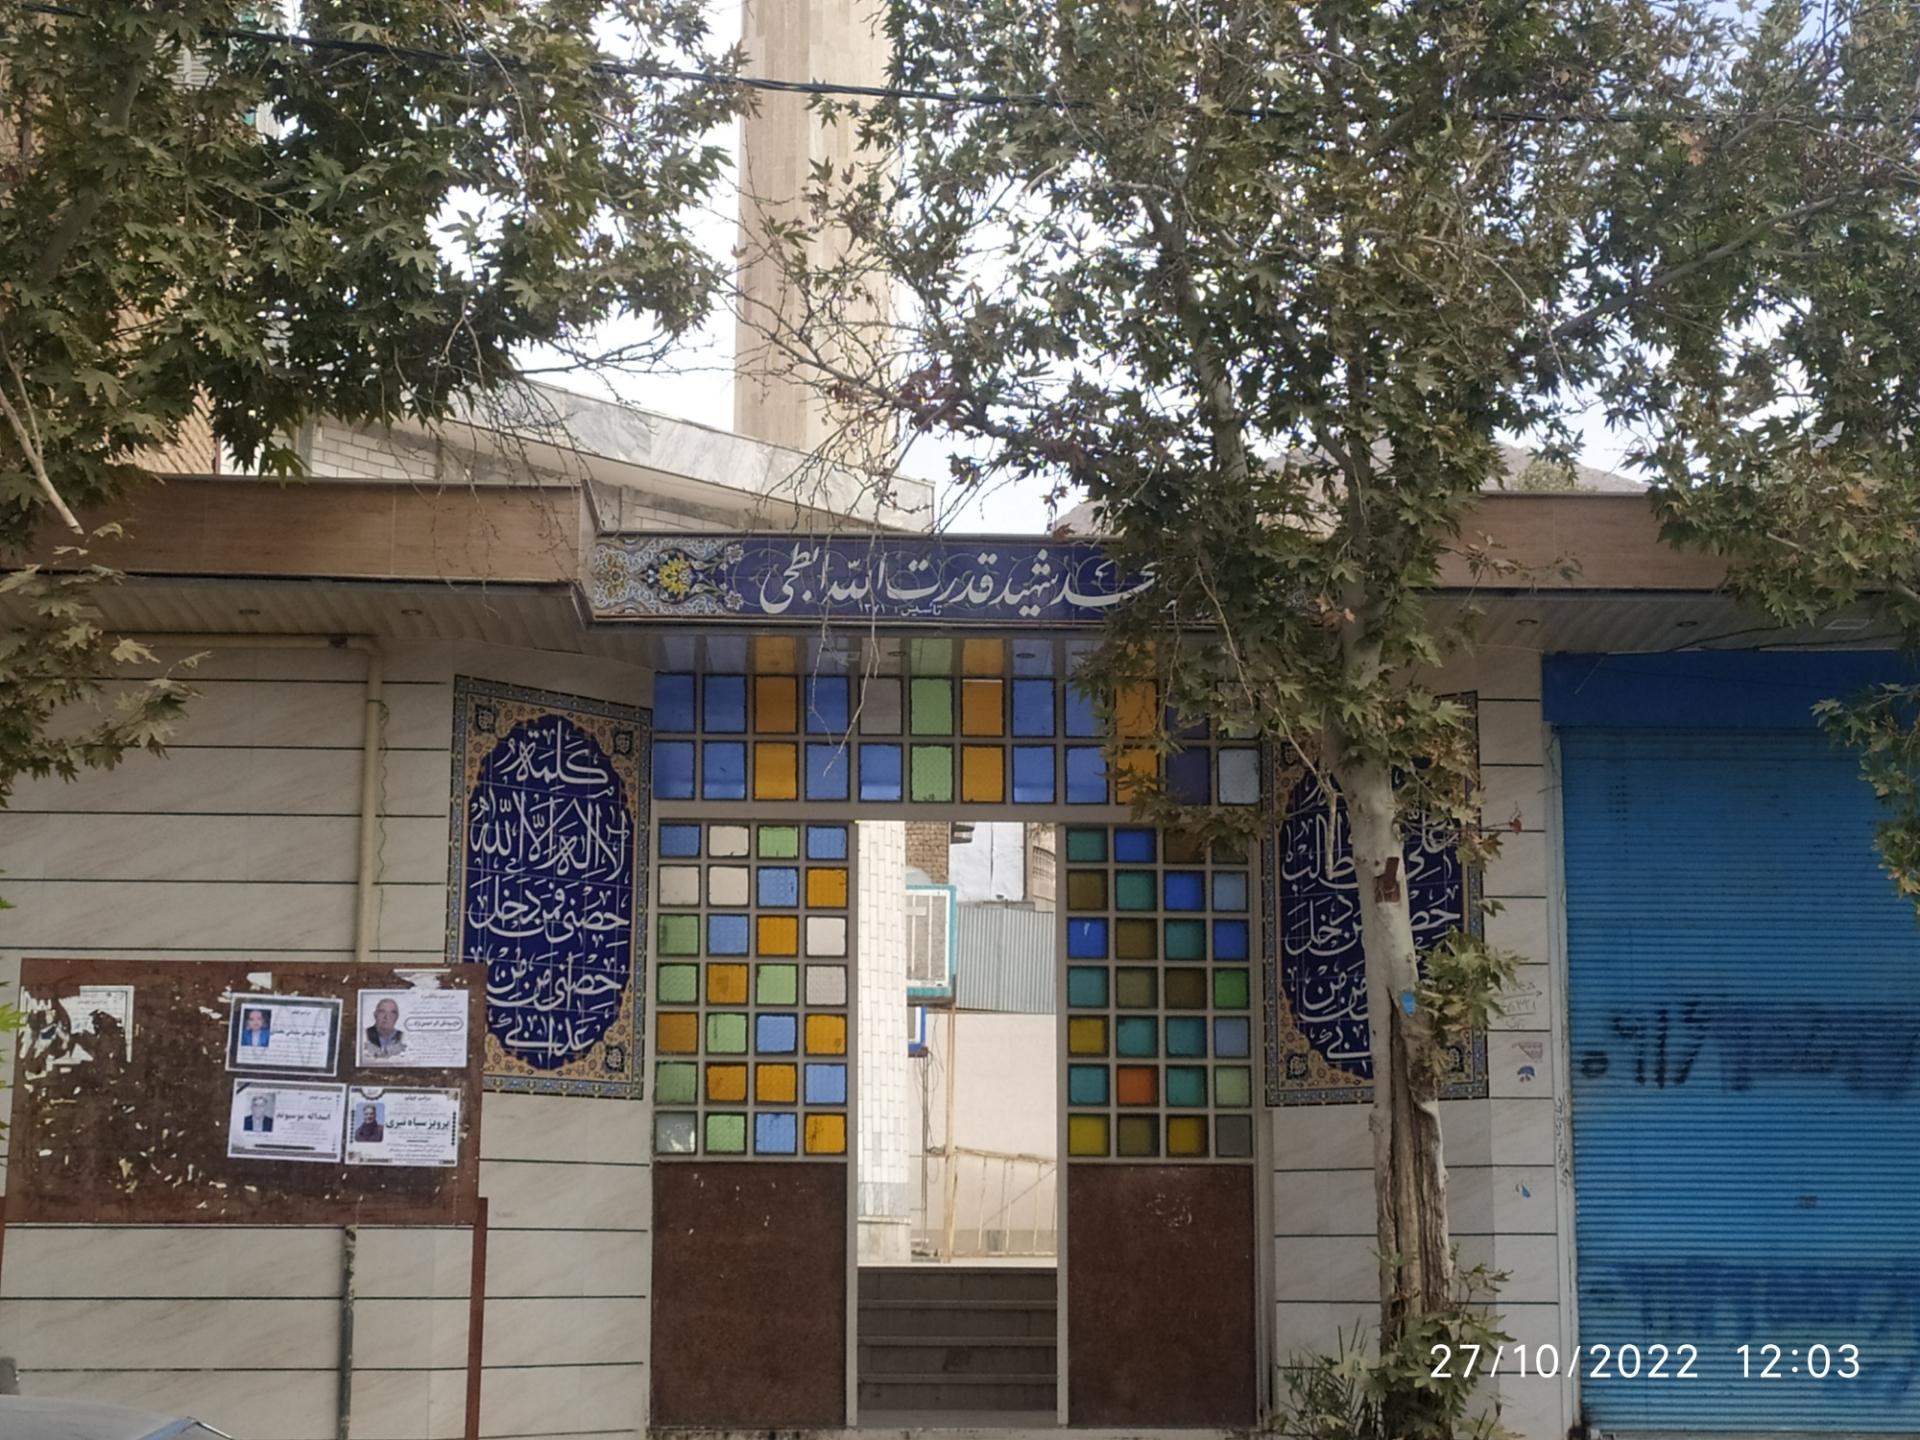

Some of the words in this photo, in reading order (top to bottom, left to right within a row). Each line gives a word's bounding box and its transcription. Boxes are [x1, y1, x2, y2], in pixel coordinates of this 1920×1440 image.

[759, 542, 828, 614] ابطحی
[886, 552, 998, 604] قدرت
[988, 548, 1060, 617] شهید
